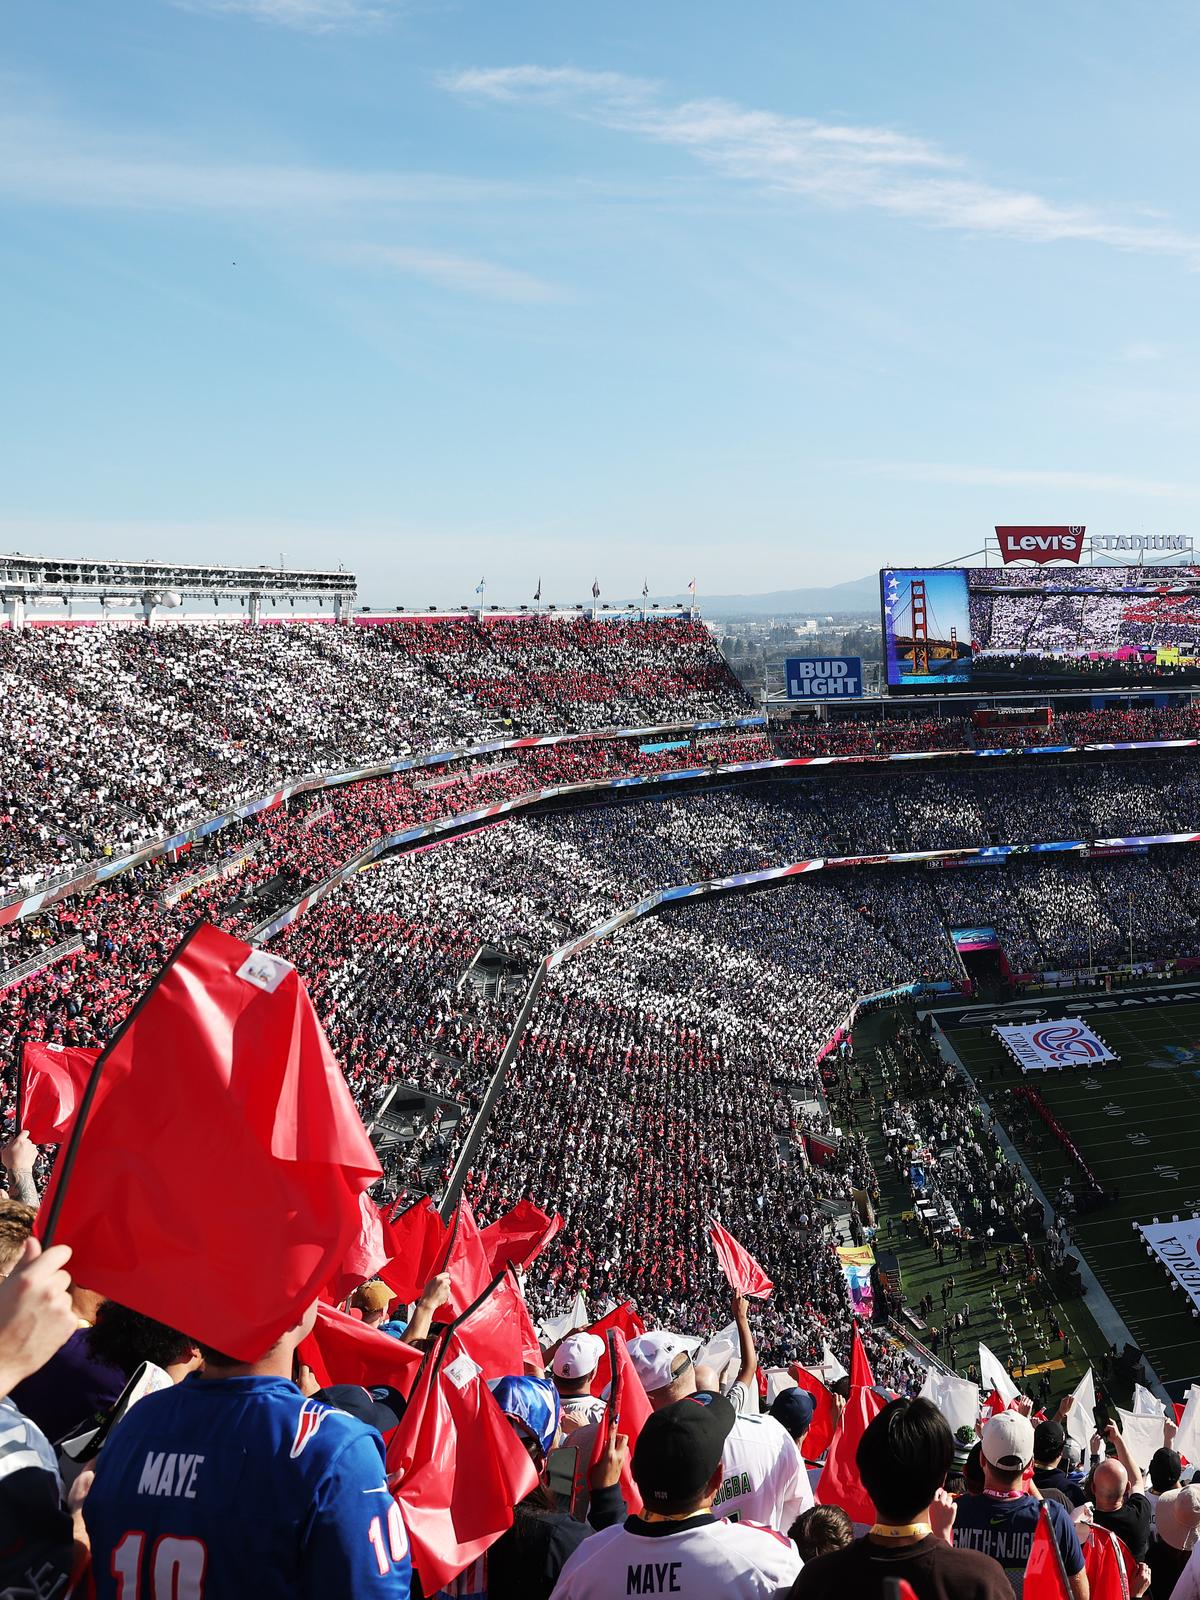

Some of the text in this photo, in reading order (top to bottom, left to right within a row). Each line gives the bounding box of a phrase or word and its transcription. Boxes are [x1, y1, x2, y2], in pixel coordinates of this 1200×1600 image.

[1090, 534, 1187, 551] STADIUM
[791, 677, 858, 695] LIGHT
[800, 661, 848, 678] BUD
[1007, 1032, 1044, 1064] AMERICA
[137, 1451, 205, 1498] MAYE
[367, 1500, 410, 1576] 10
[952, 1528, 1037, 1561] SMITH-NJIG
[111, 1530, 207, 1600] 10
[626, 1562, 682, 1596] MAYE
